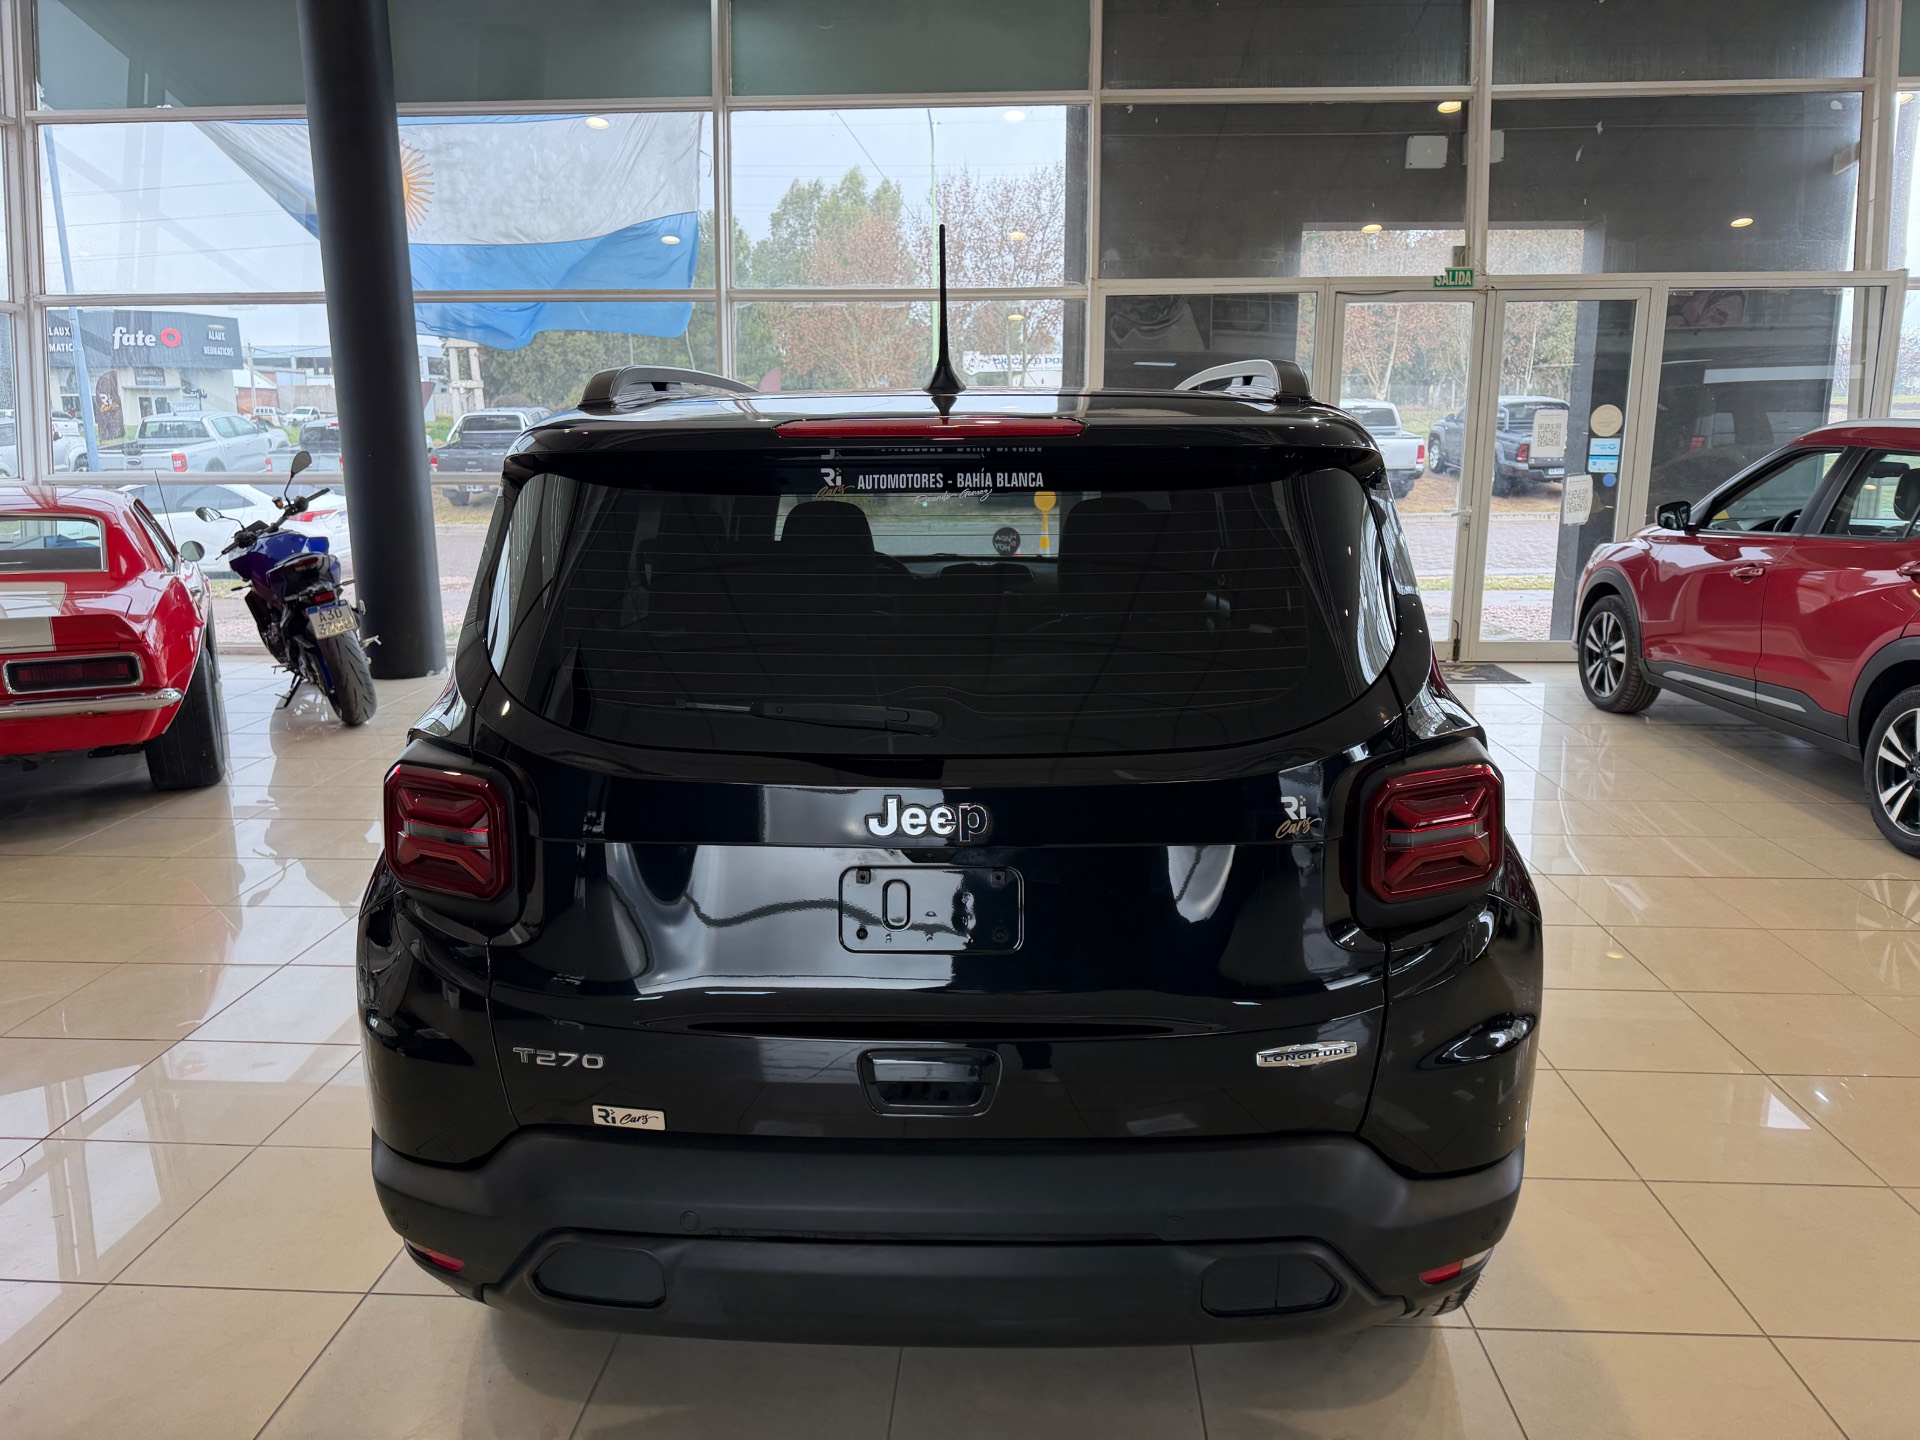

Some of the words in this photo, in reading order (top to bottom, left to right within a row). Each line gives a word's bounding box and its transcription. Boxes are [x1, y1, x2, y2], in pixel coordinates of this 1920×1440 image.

[1435, 270, 1472, 286] SALIDA
[112, 326, 157, 350] fate
[208, 330, 226, 341] ALAUX
[203, 345, 234, 357] NEUMATICOS
[820, 467, 842, 487] Ri
[857, 473, 944, 490] AUTOMOTORES
[957, 468, 993, 488] BAHÍA
[996, 472, 1044, 488] BLANCA
[815, 484, 856, 500] Cars
[1280, 795, 1307, 820] Ri
[866, 795, 988, 842] Jeep
[1275, 817, 1323, 839] Cars
[512, 1046, 605, 1069] T270
[1262, 1045, 1354, 1063] LONGITUDE
[597, 1108, 617, 1125] Ri
[619, 1113, 659, 1125] Cars
